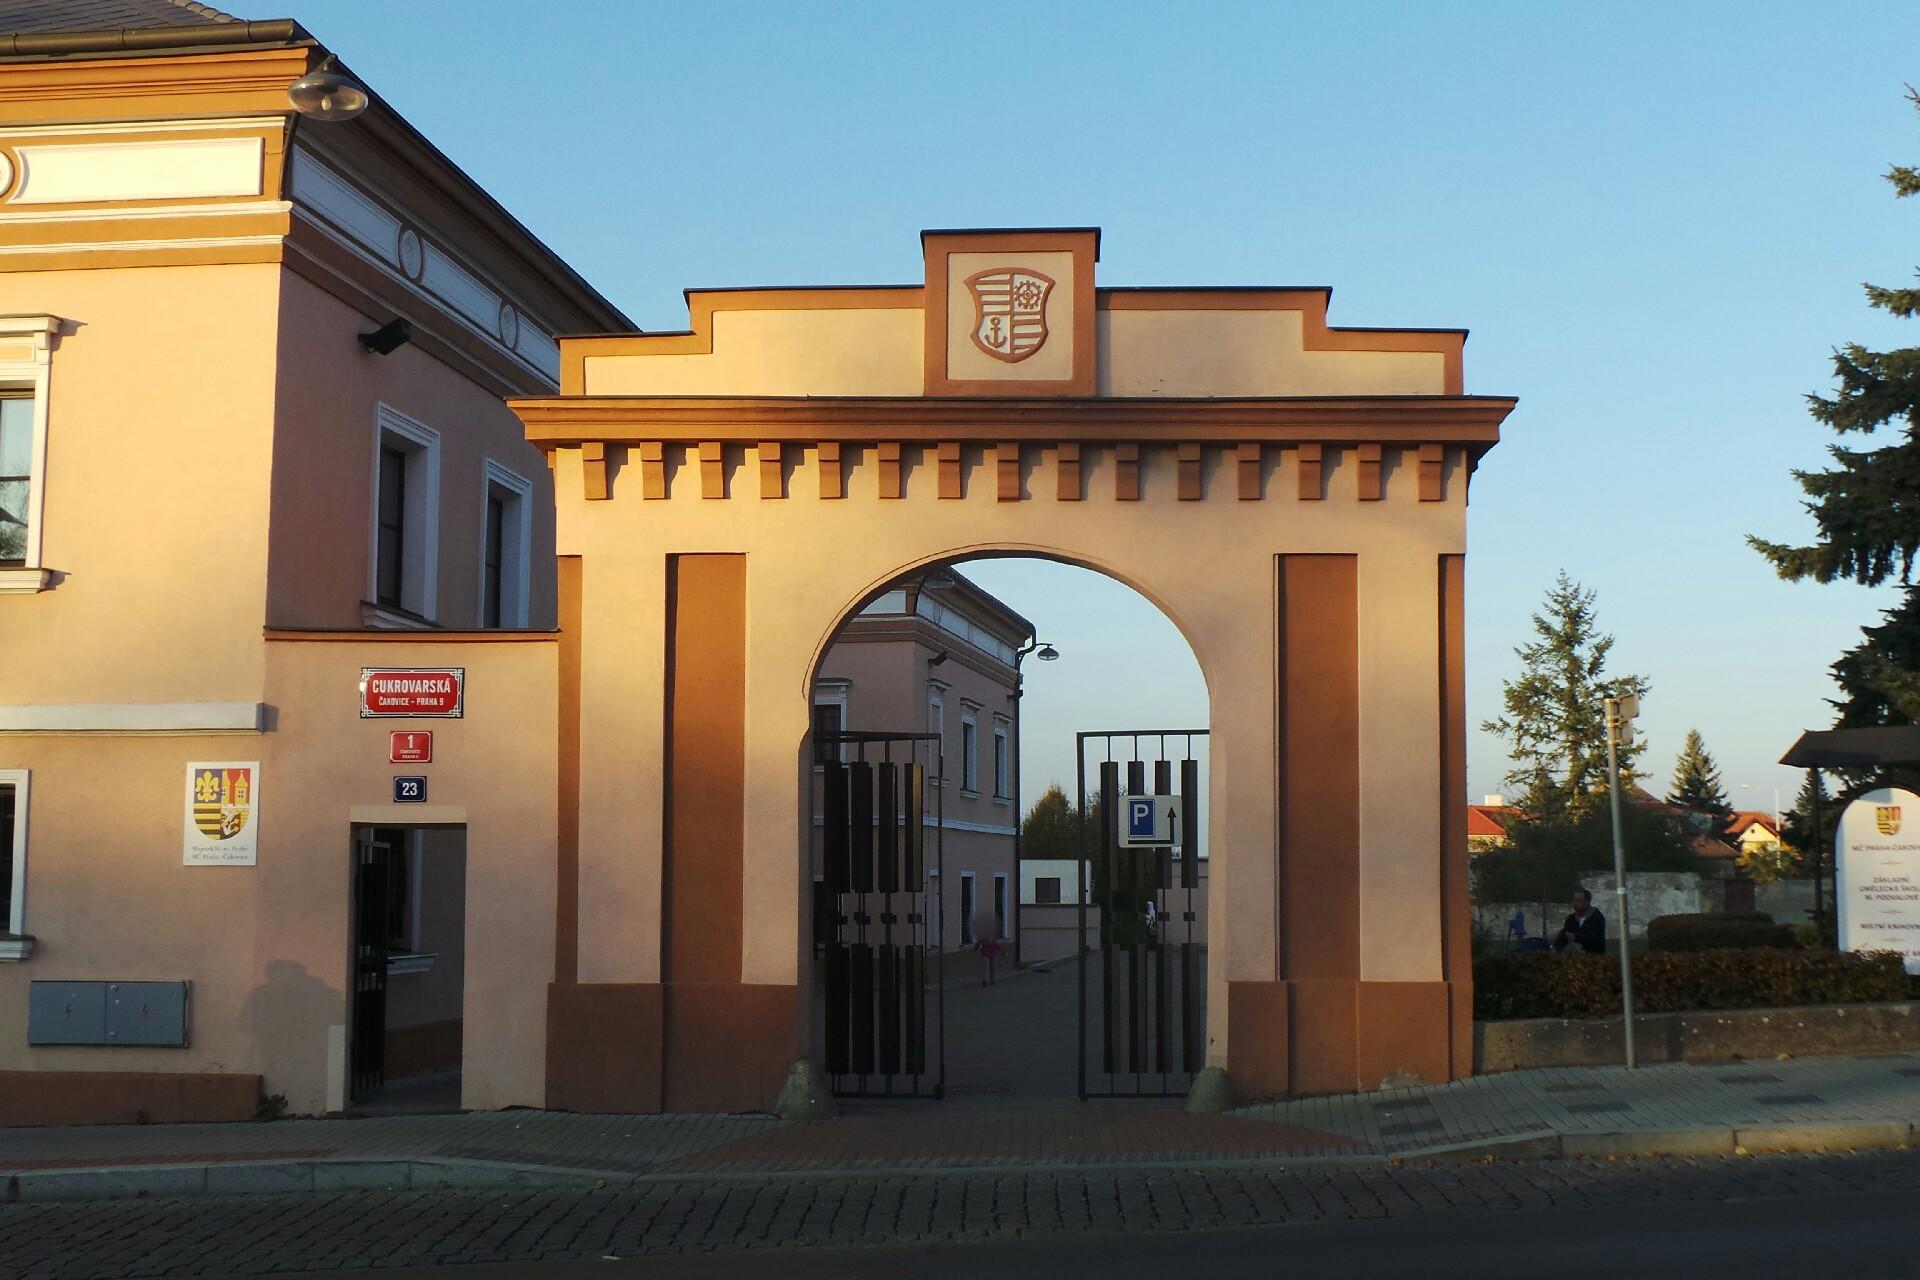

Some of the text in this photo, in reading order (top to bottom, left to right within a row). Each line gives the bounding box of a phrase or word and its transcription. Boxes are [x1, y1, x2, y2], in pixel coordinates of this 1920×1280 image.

[372, 678, 451, 693] CUKROVARSKÁ
[378, 696, 410, 706] ČAKOVICE
[416, 697, 438, 706] PRAHA
[439, 697, 444, 706] 9
[408, 734, 414, 748] 1
[402, 782, 418, 796] 23
[1134, 804, 1149, 826] P
